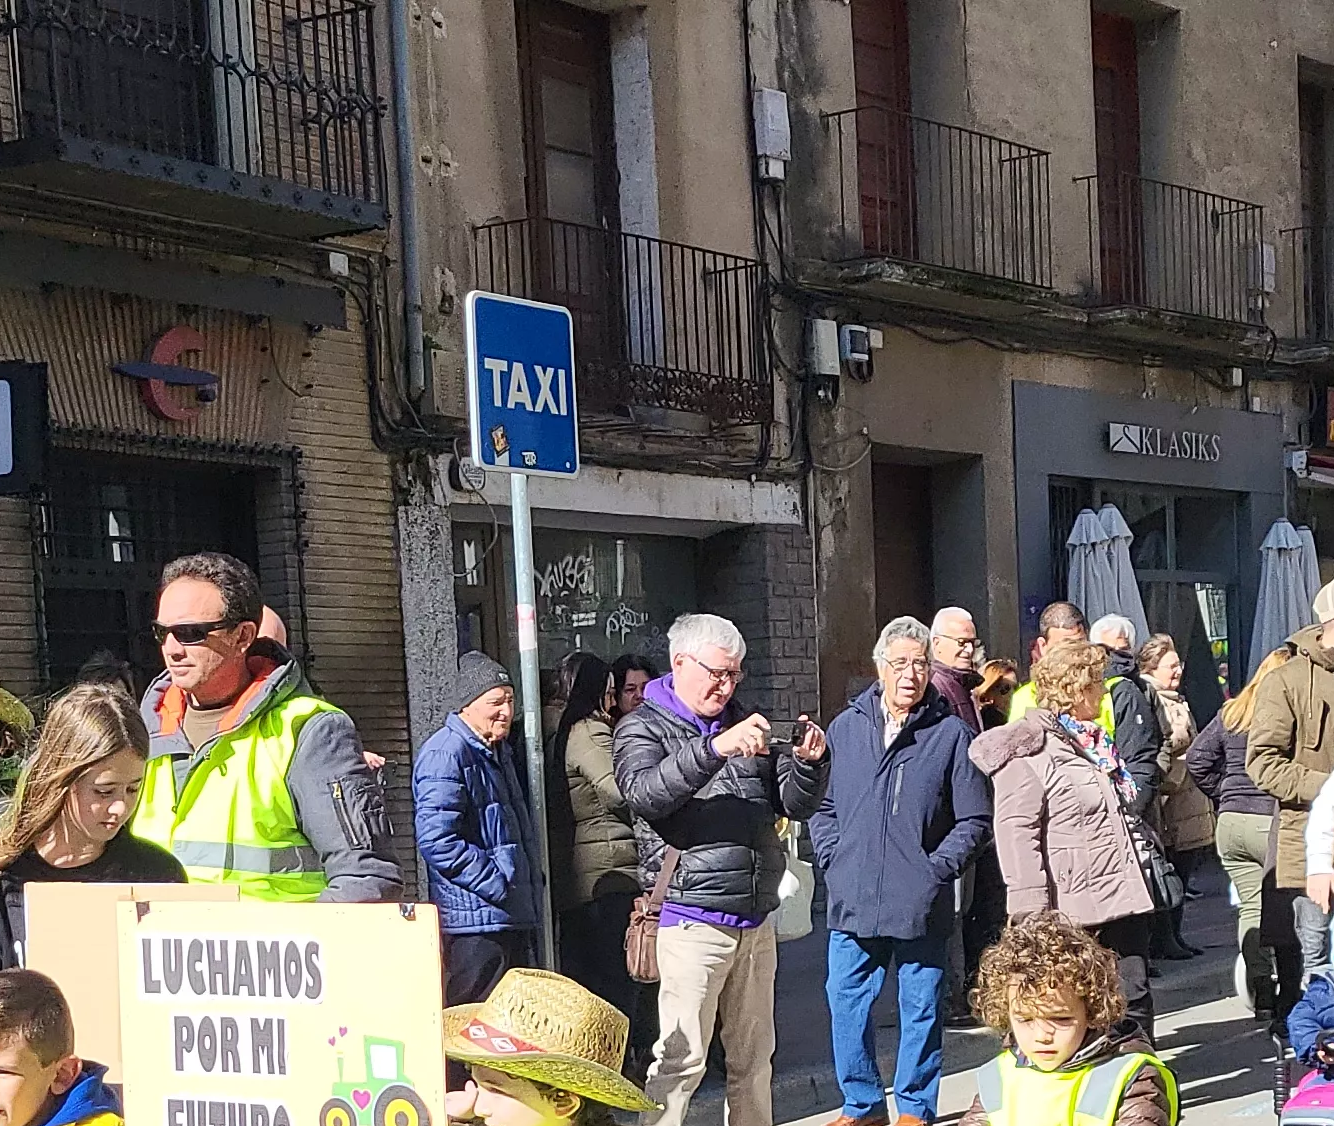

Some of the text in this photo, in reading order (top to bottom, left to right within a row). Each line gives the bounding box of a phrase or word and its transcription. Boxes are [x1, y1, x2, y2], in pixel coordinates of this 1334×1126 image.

[484, 357, 567, 416] TAXI
[1141, 426, 1221, 461] KLASIKS
[141, 938, 323, 999] LUCHAMOS
[174, 1015, 287, 1075] POR MI
